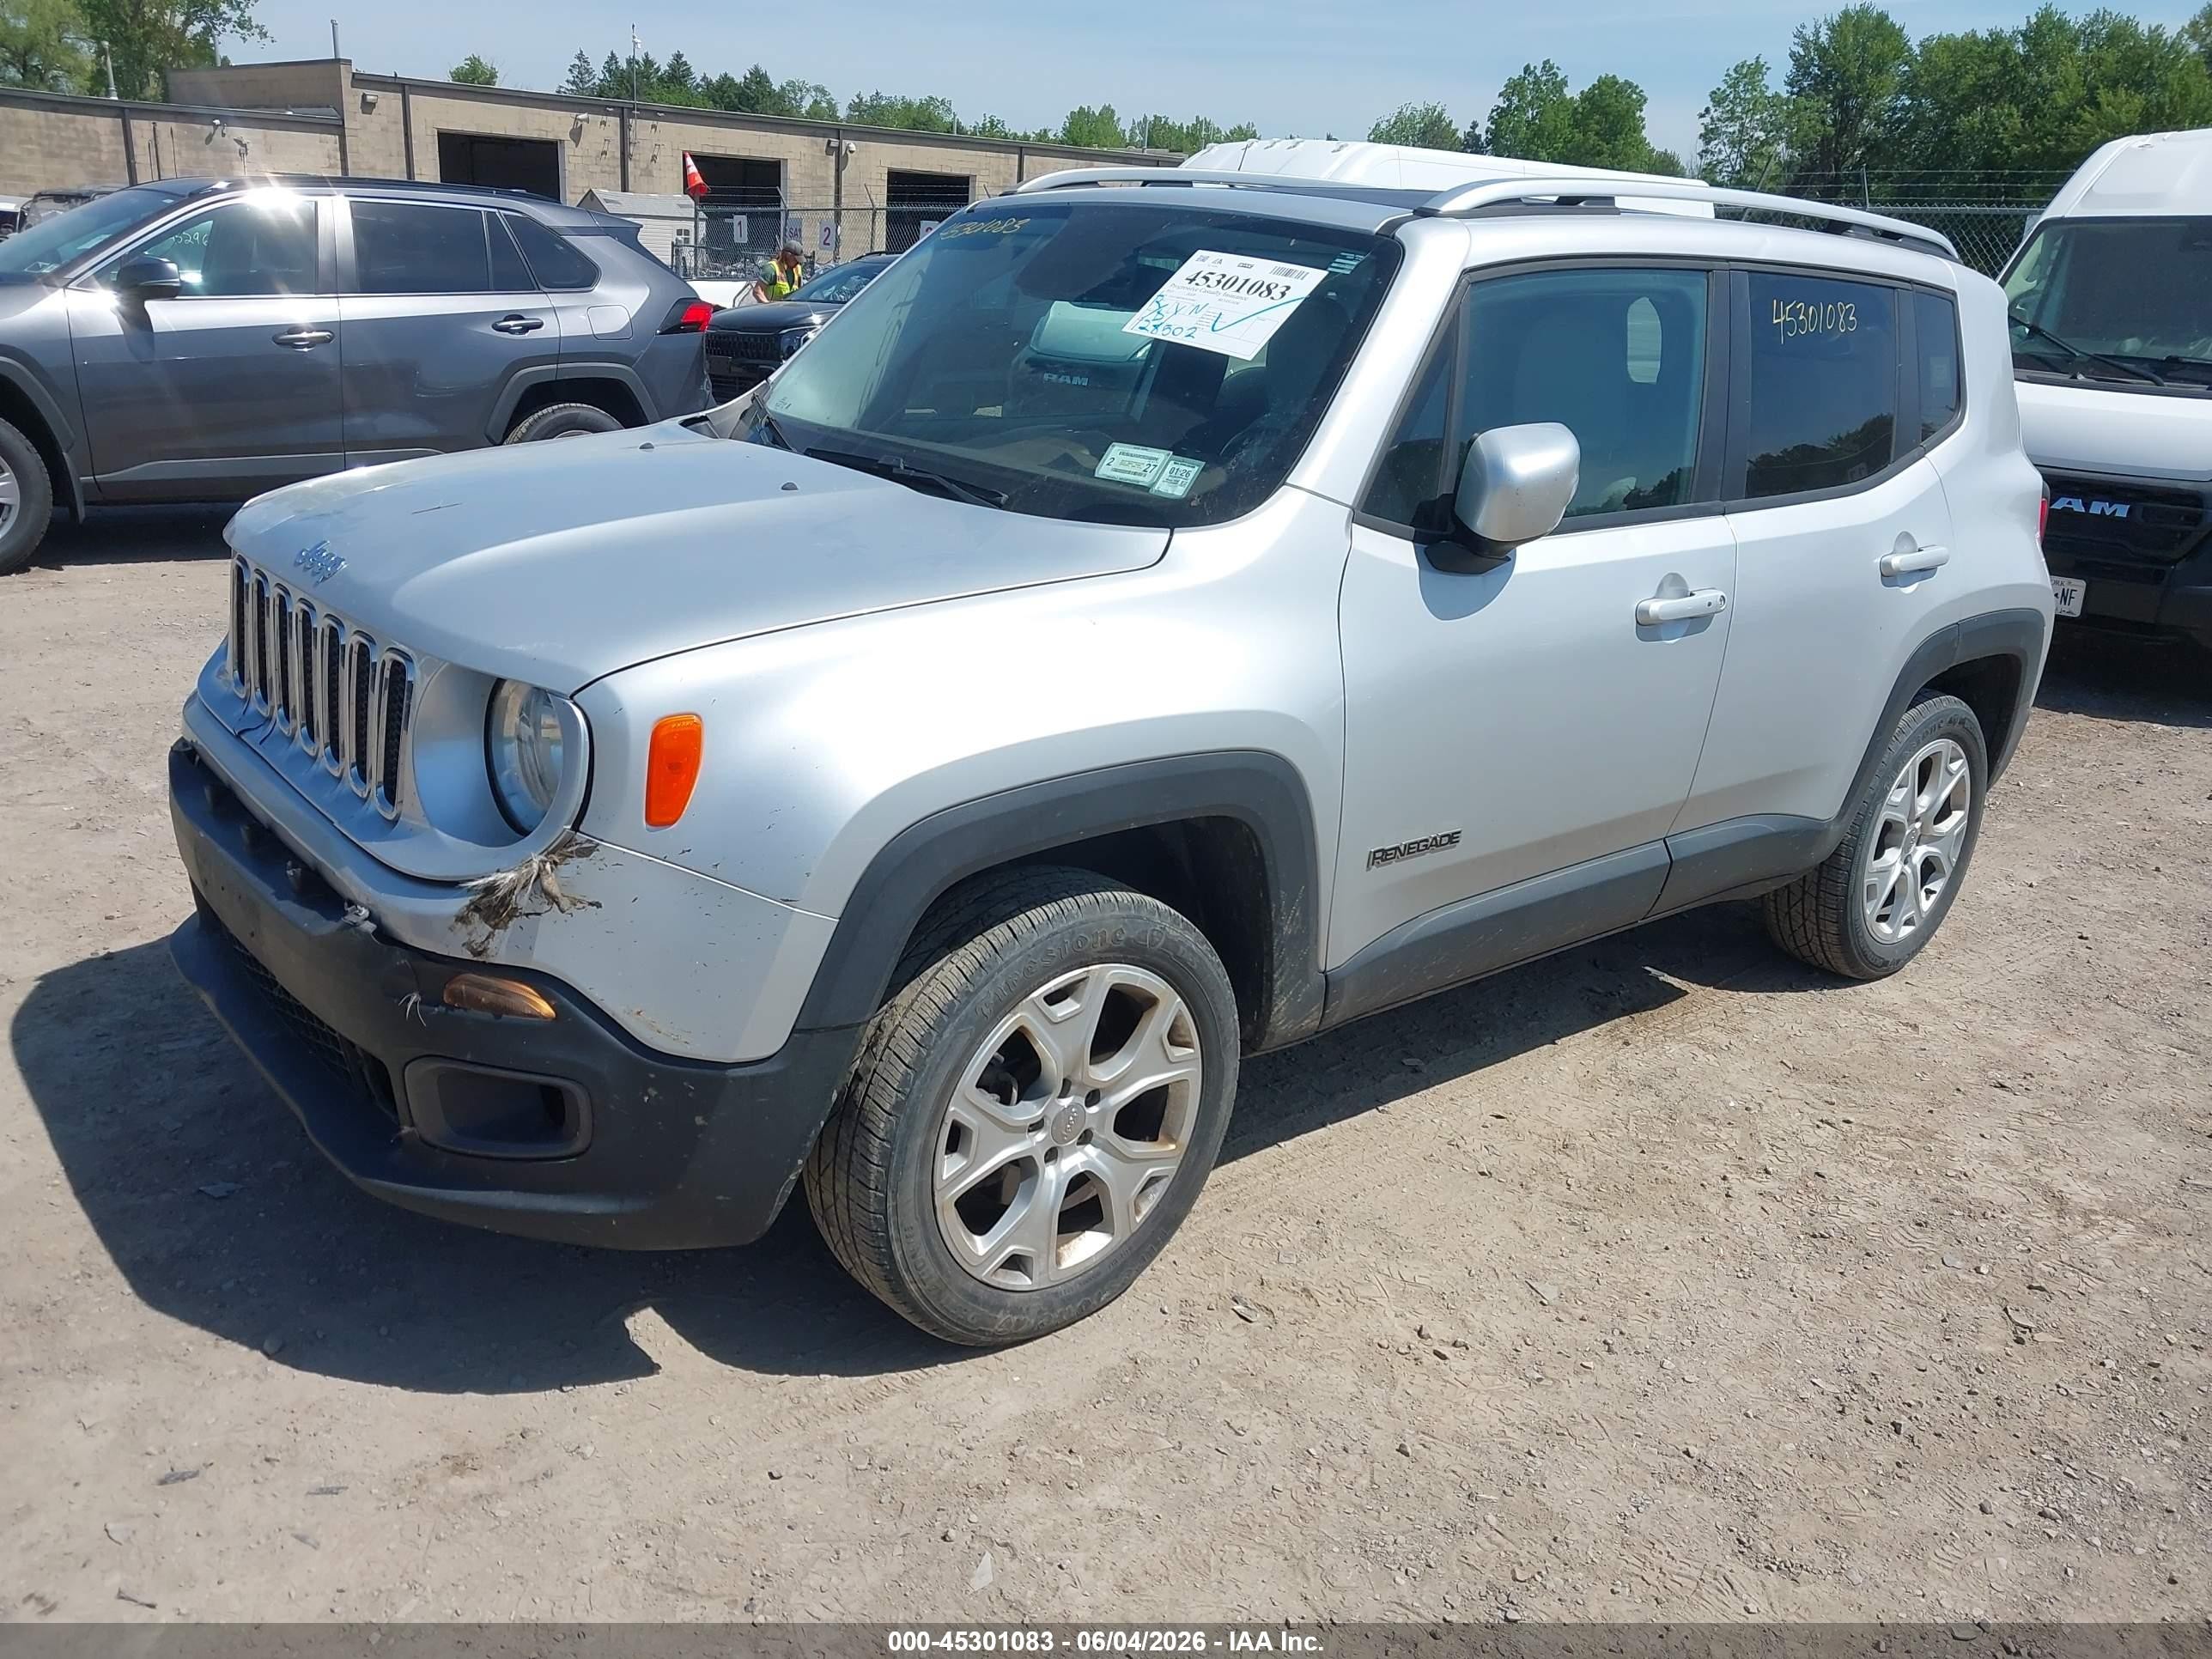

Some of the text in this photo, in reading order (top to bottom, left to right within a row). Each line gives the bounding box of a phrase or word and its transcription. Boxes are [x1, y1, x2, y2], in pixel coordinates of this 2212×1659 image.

[737, 220, 742, 238] 1
[823, 227, 831, 246] 2
[1185, 270, 1291, 301] 45301083
[1772, 299, 1857, 344] 45301083
[1043, 372, 1089, 386] RAM
[1106, 457, 1115, 466] 2
[1143, 463, 1158, 474] 27
[2050, 497, 2130, 518] AM
[1366, 829, 1462, 872] RENEGADE
